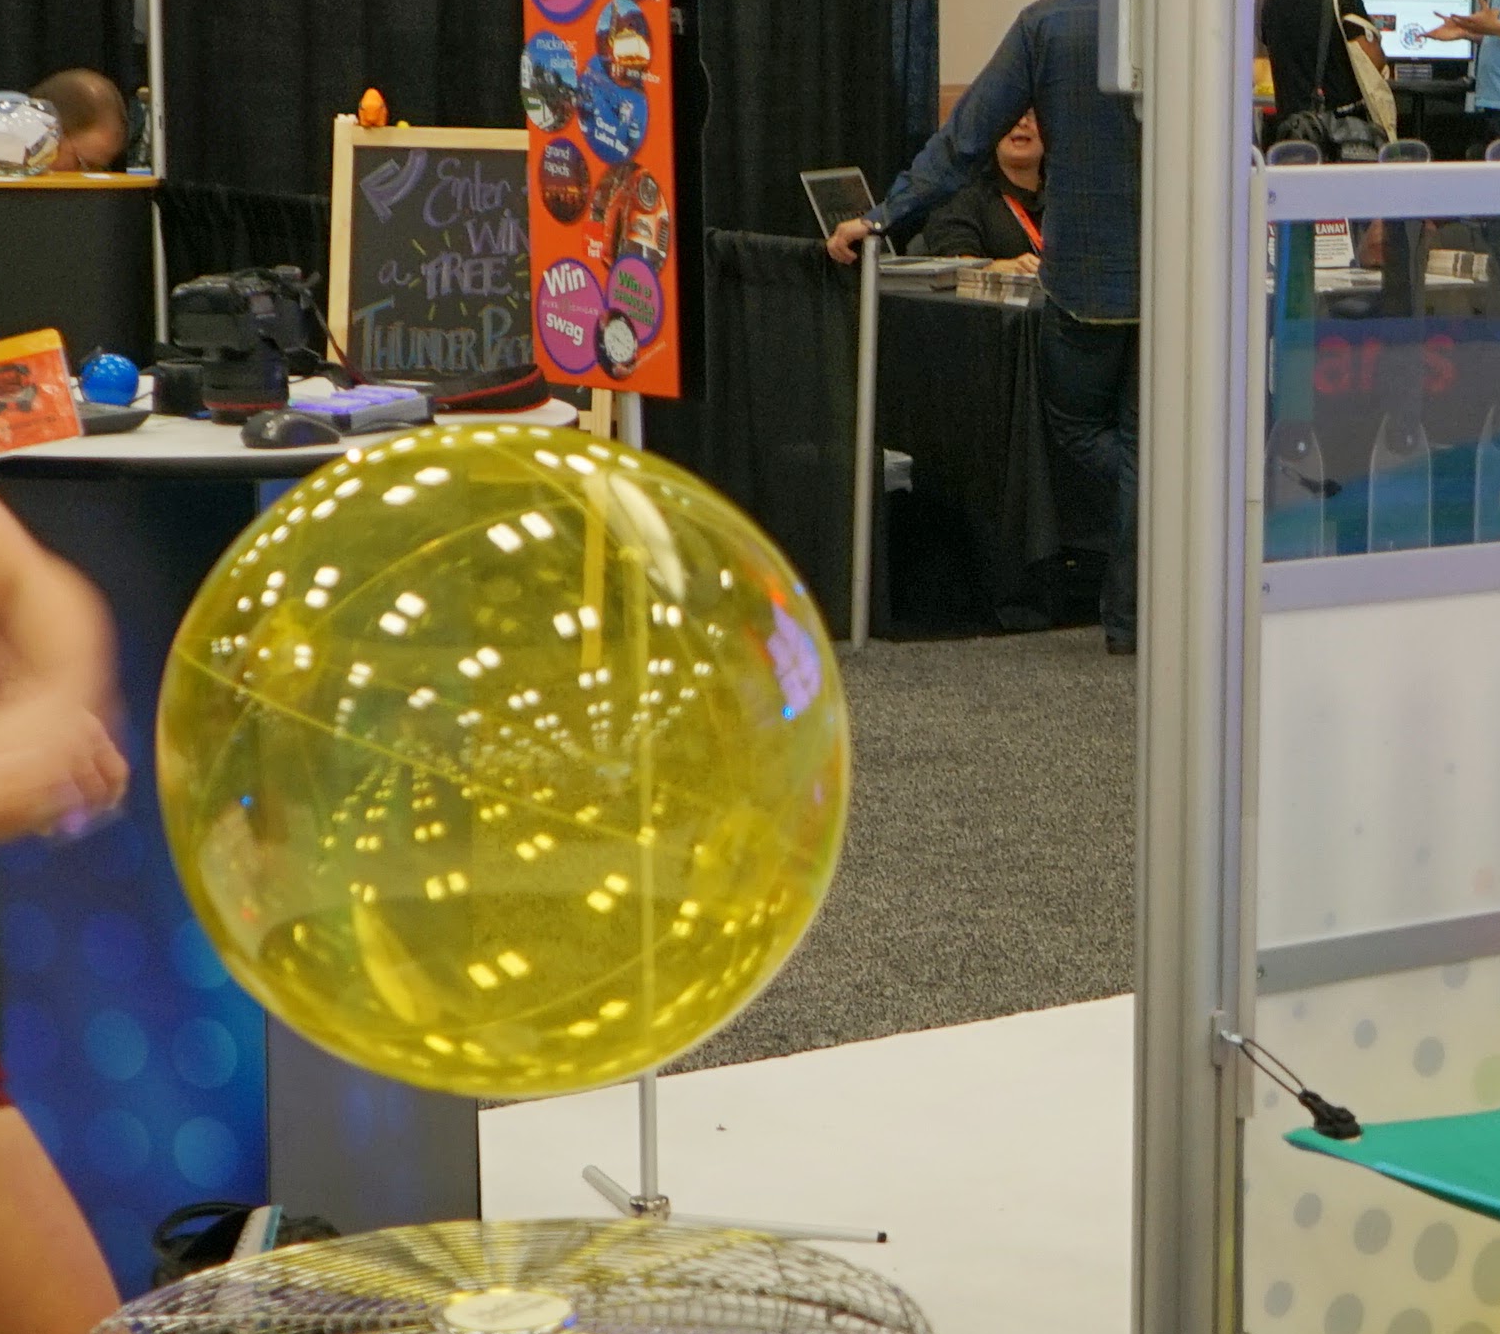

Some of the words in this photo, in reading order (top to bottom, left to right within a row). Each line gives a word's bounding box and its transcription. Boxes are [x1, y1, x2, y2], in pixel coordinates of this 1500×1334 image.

[423, 158, 511, 228] Enter
[378, 259, 412, 286] a
[543, 263, 587, 298] Win
[352, 295, 483, 374] THUNDER
[546, 312, 585, 346] swag
